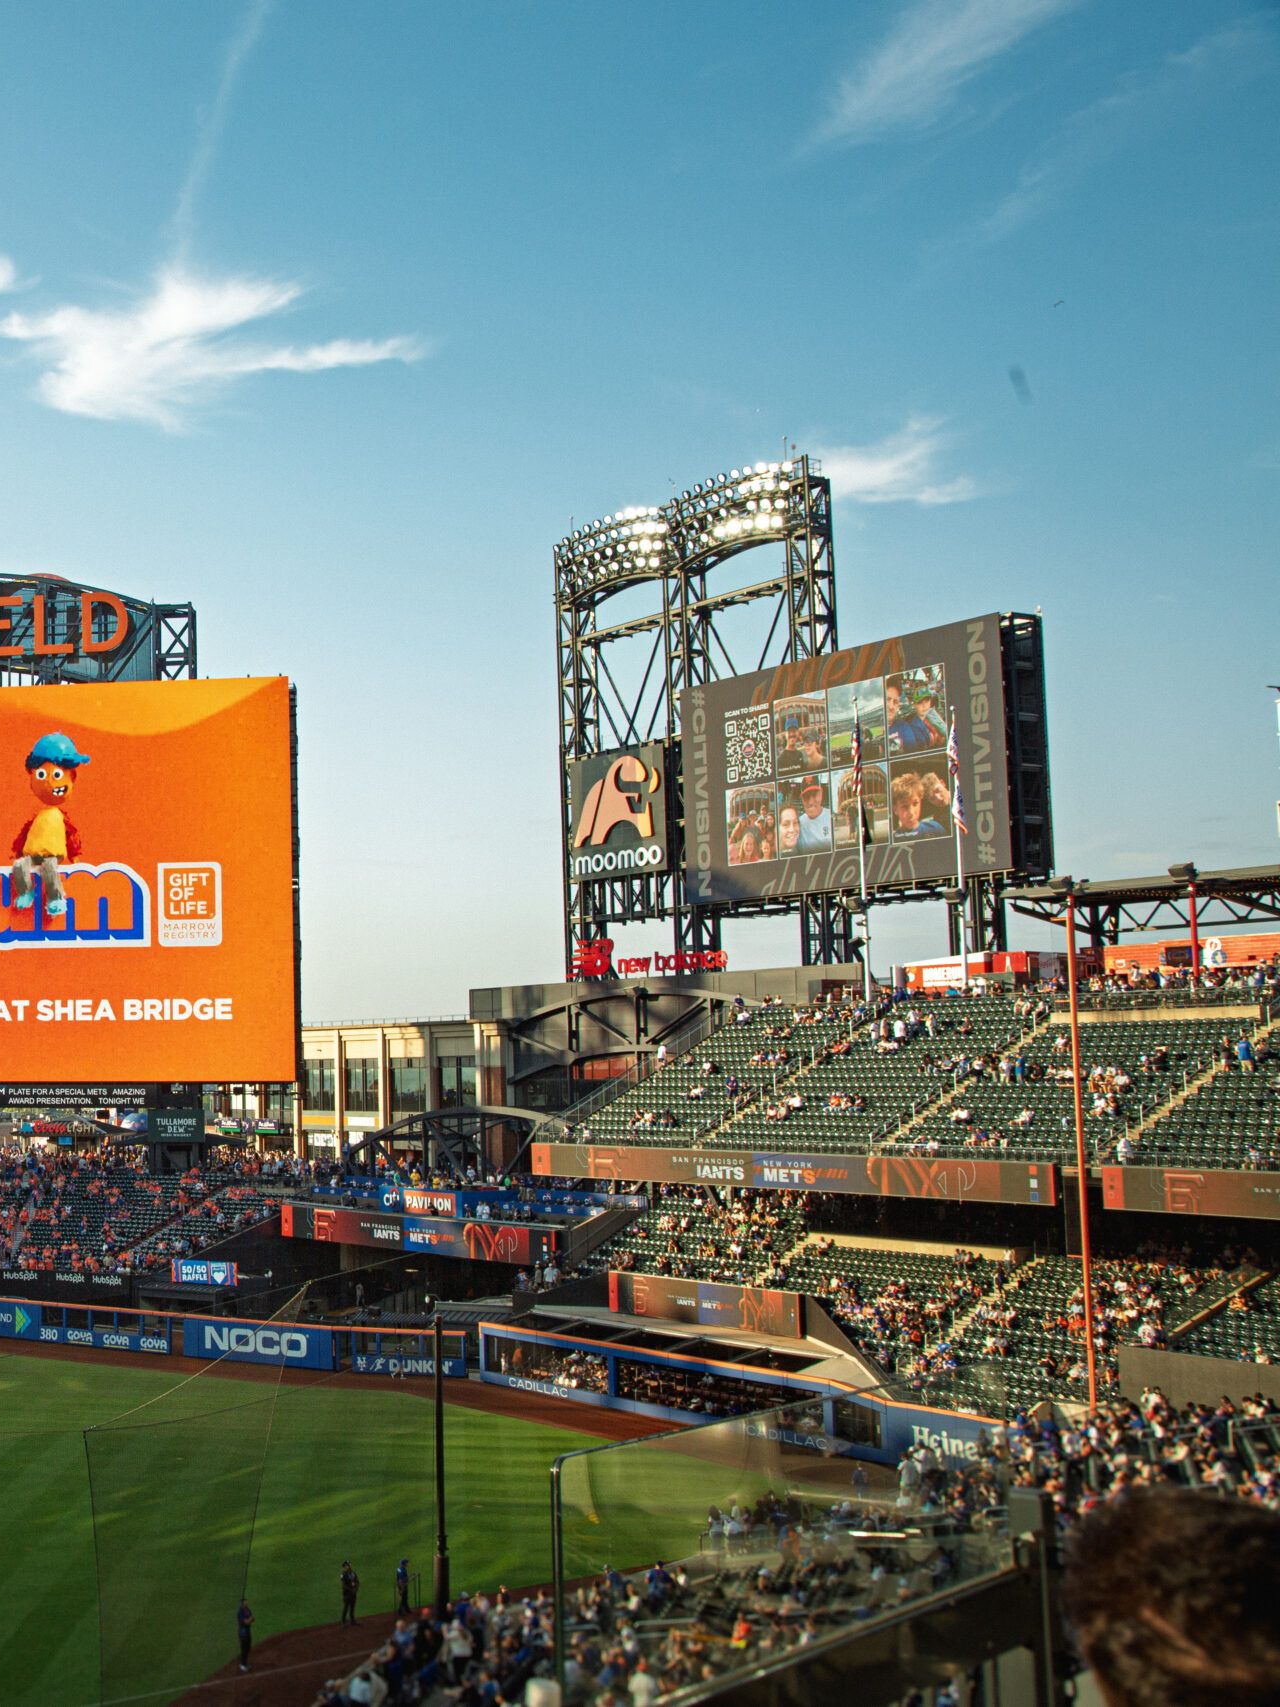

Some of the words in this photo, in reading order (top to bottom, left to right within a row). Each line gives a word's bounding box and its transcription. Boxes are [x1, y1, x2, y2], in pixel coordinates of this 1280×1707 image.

[724, 709, 740, 718] SCAN
[740, 707, 749, 715] TO
[748, 703, 769, 713] SHARE!
[967, 621, 996, 866] #CITIVISION
[691, 690, 712, 897] #CITIVISION
[575, 845, 662, 875] moomoo
[169, 872, 210, 887] GIFT
[169, 887, 195, 901] OF
[169, 901, 208, 915] LIFE
[163, 922, 216, 931] MARROW
[163, 931, 216, 940] REGISTRY
[618, 956, 652, 975] new
[654, 948, 729, 972] balance
[36, 999, 116, 1021] SHEA
[123, 998, 233, 1021] BRIDGE
[8, 1088, 31, 1096] PLATE
[32, 1088, 48, 1096] FOR
[55, 1088, 86, 1096] SPECIAL
[87, 1087, 108, 1095] METS
[112, 1087, 146, 1095] AMAZING
[8, 1097, 36, 1105] AWARD
[36, 1097, 93, 1105] PRESENTATION.
[98, 1097, 132, 1105] TONIGHT
[132, 1097, 145, 1105] WE
[32, 1119, 67, 1134] Coors
[66, 1124, 97, 1134] LIGHT
[156, 1118, 197, 1126] TULLAMORE
[693, 1157, 745, 1166] FRANCISCO
[786, 1161, 813, 1169] YORK
[695, 1164, 745, 1181] IANTS
[763, 1168, 817, 1184] METS
[373, 1228, 401, 1241] IANTS
[409, 1232, 438, 1245] METS
[3, 1269, 38, 1281] HubSpot
[181, 1265, 207, 1275] 50/50
[55, 1272, 85, 1284] HubSpot
[92, 1274, 122, 1286] HubSpot
[181, 1272, 208, 1282] RAFFLE
[40, 1328, 58, 1341] 380
[67, 1329, 93, 1342] GOYA
[103, 1333, 130, 1346] GOYA
[140, 1337, 168, 1350] GOYA
[204, 1325, 306, 1358] NOCO
[508, 1377, 569, 1398] CADILLAC
[747, 1425, 828, 1450] CADILLAC
